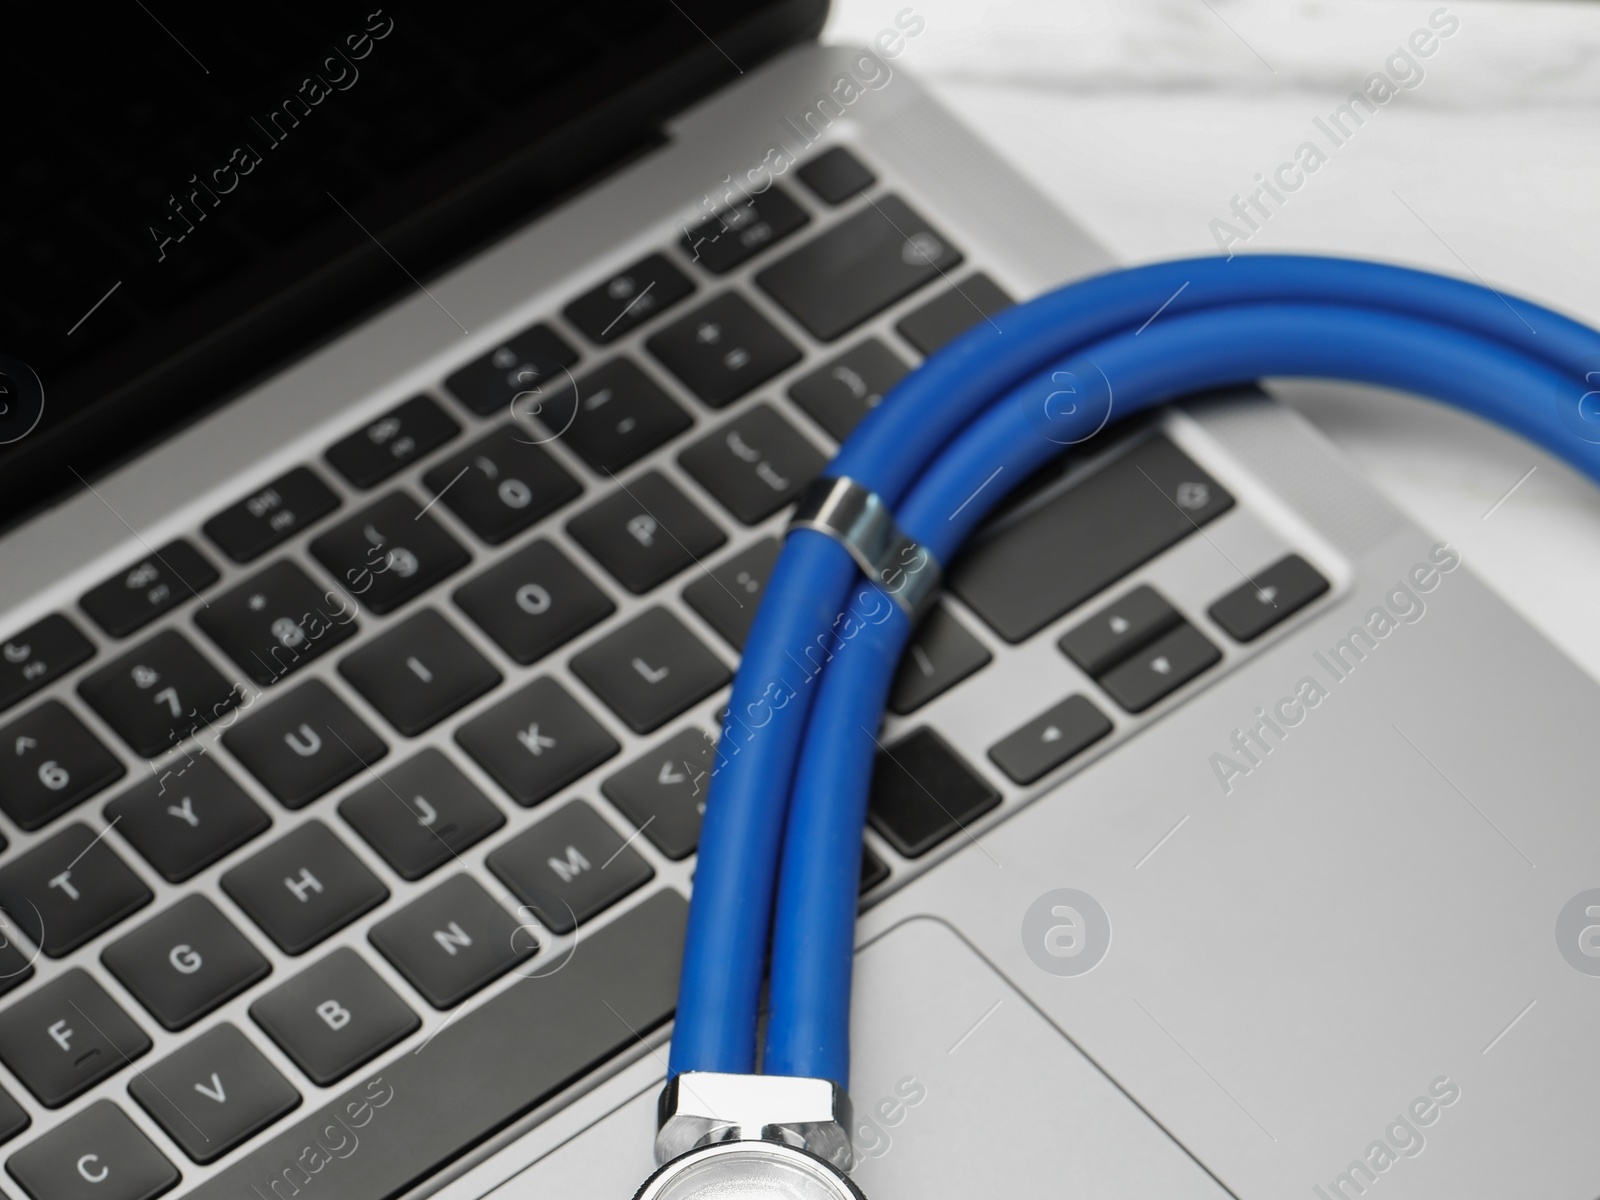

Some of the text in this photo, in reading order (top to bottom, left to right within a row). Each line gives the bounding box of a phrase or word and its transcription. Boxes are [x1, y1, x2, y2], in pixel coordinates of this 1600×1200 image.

[632, 657, 669, 684] L
[154, 686, 182, 717] 7
[284, 723, 323, 757] U
[517, 723, 555, 755] K
[37, 760, 70, 791] 6
[168, 796, 199, 827] Y
[414, 796, 438, 825] J
[547, 845, 591, 882] M
[48, 870, 80, 901] T
[284, 867, 324, 903] H
[432, 921, 473, 956] N
[168, 943, 203, 975] G
[315, 999, 352, 1031] B
[47, 1019, 74, 1052] F
[194, 1072, 227, 1104] V
[75, 1152, 110, 1184] C
